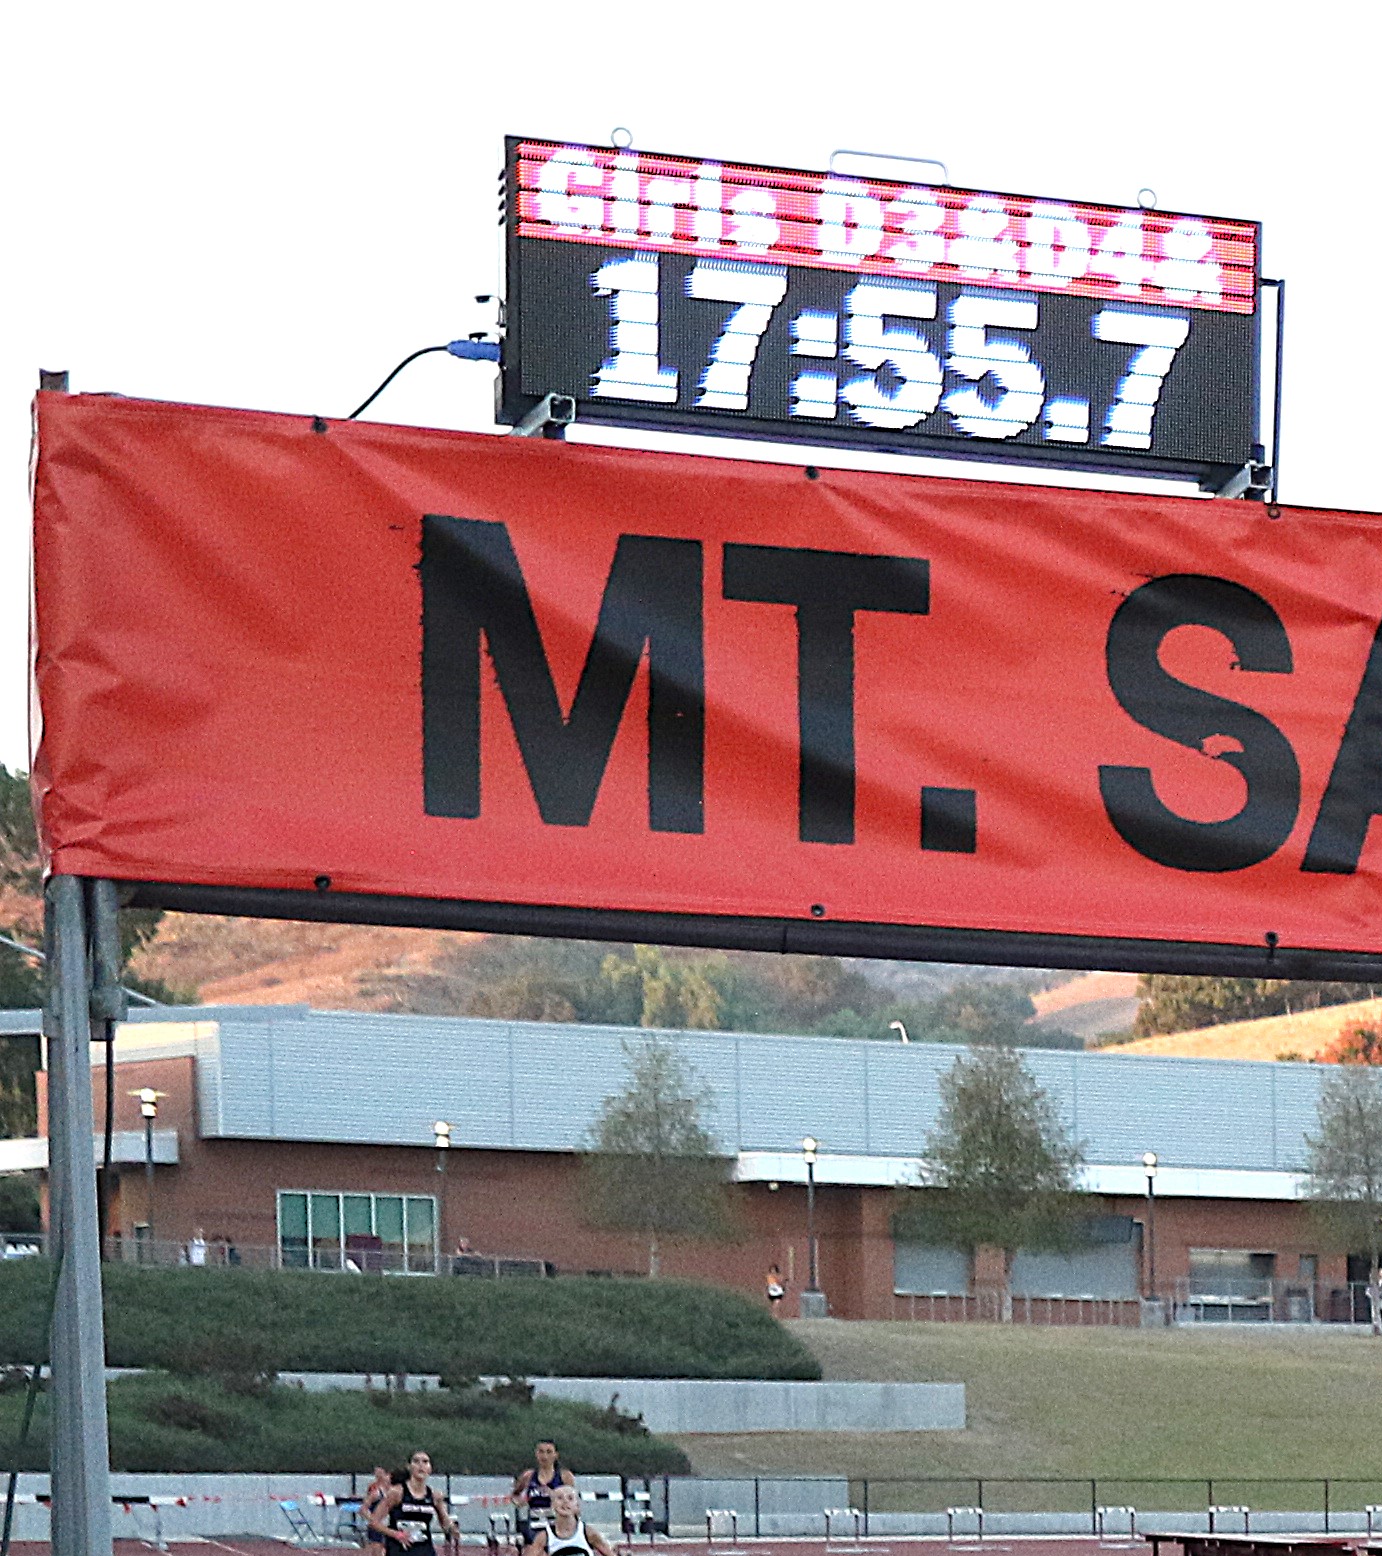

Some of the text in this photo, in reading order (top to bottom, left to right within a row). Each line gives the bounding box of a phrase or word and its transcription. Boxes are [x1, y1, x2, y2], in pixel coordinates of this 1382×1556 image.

[536, 148, 778, 249] Girls
[589, 251, 1191, 448] 17:55.7
[420, 514, 977, 854] MT.
